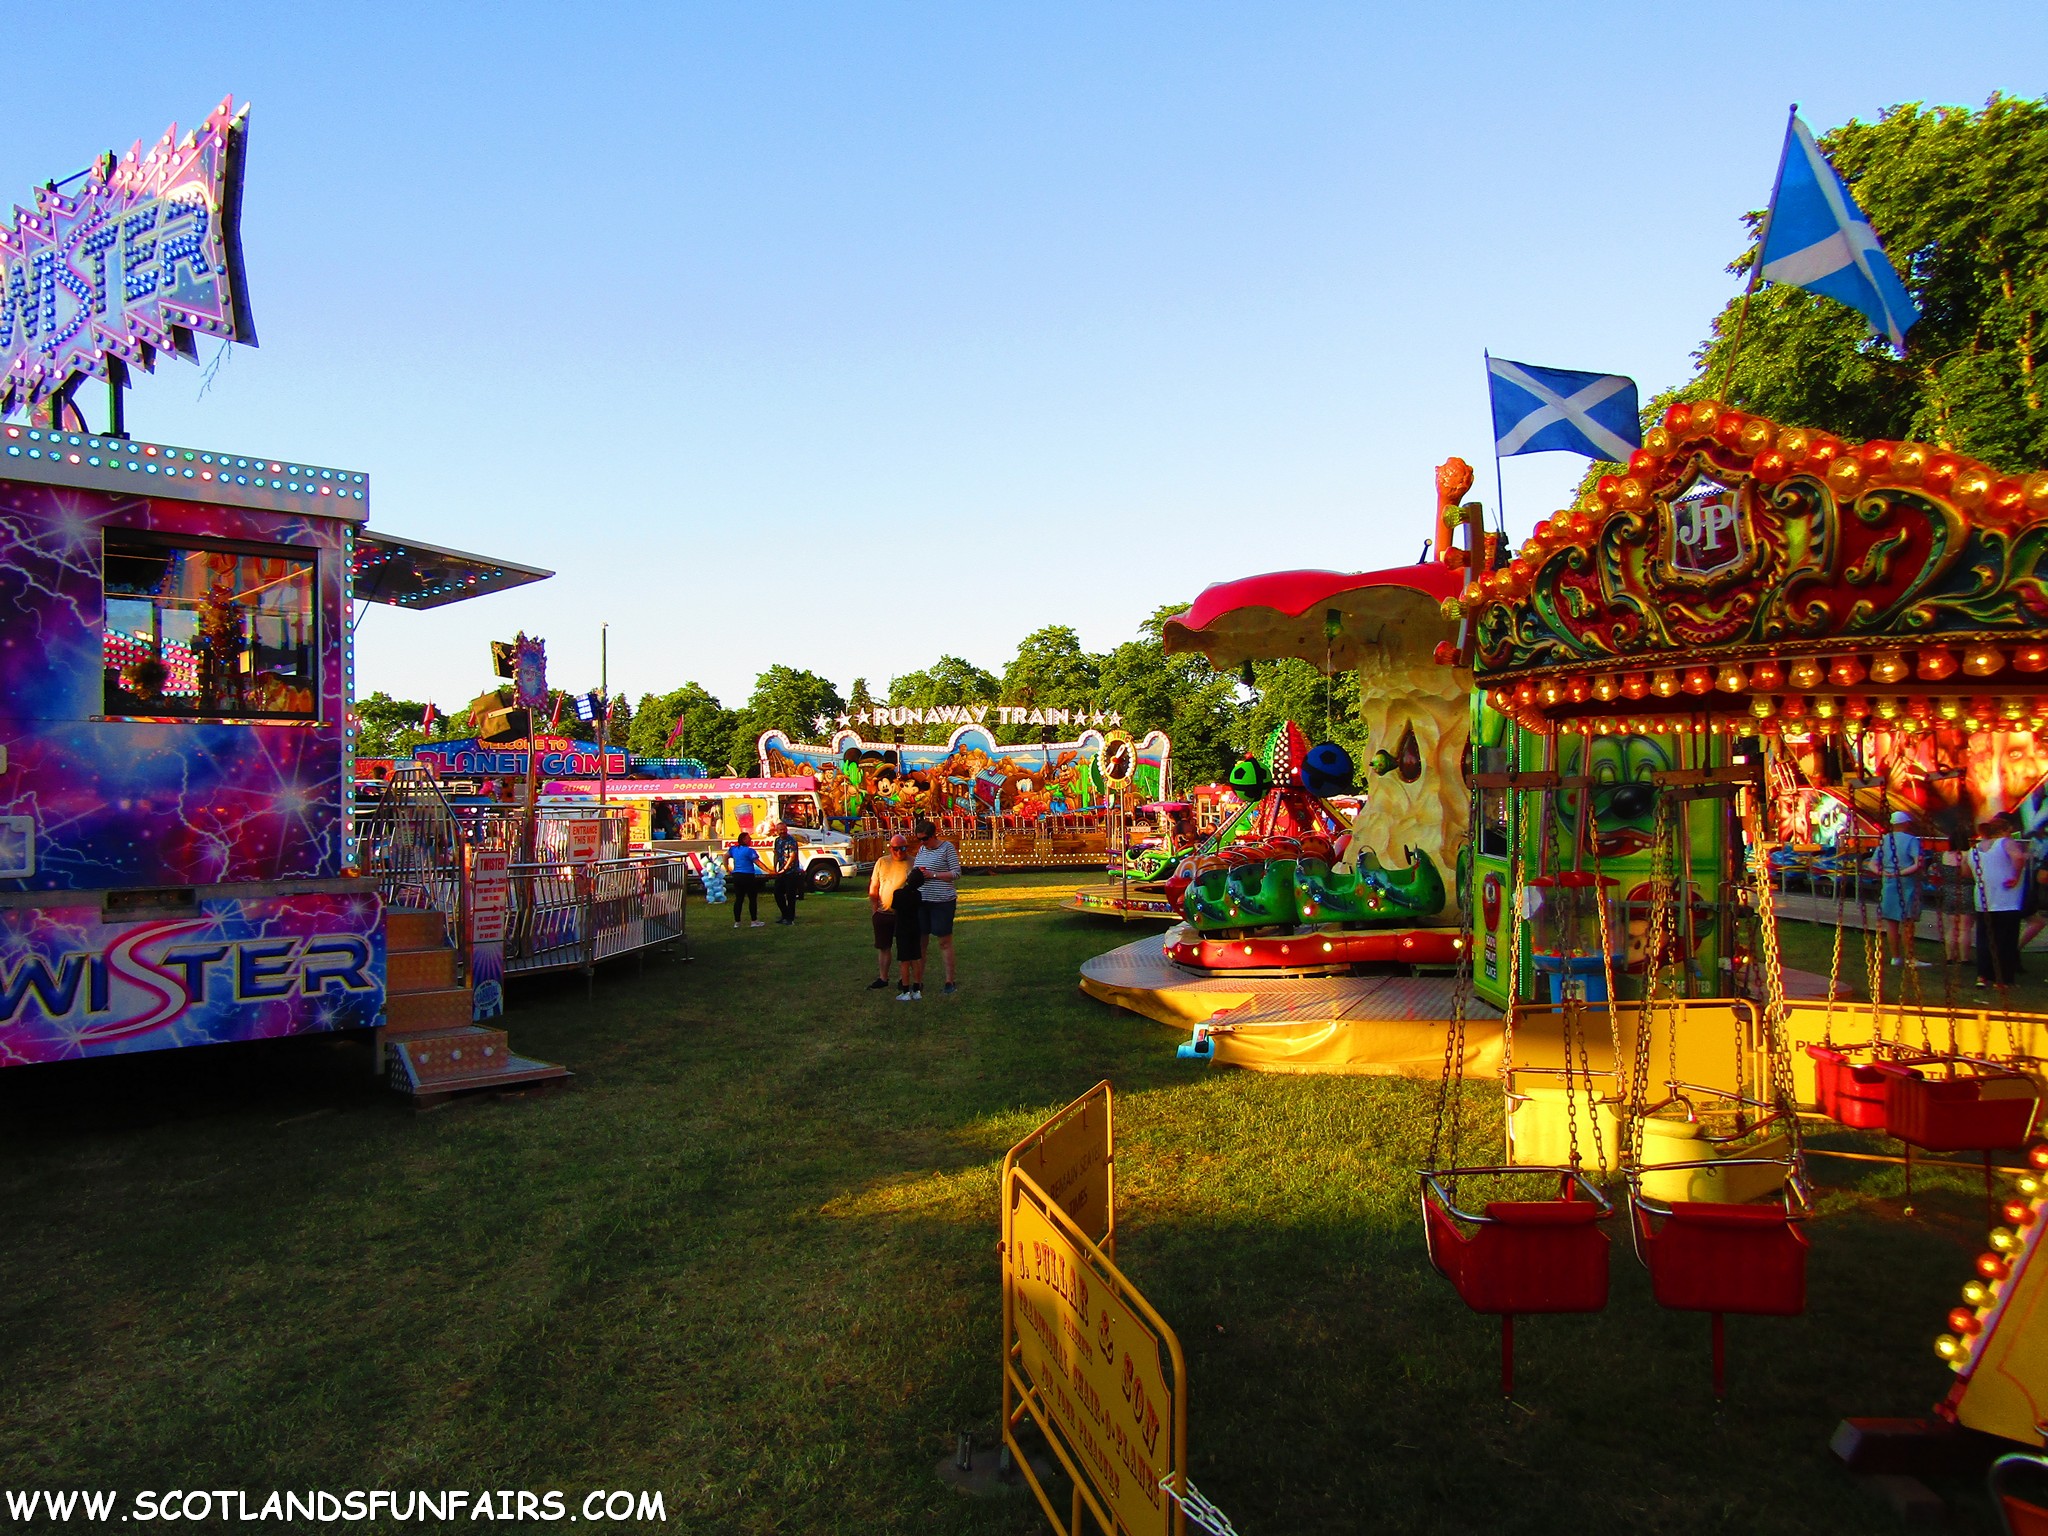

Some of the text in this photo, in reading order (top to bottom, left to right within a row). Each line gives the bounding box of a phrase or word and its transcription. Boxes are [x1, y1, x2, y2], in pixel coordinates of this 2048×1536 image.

[1680, 499, 1732, 550] JP
[873, 704, 1069, 726] RUNAWAY TRAIN
[478, 739, 568, 750] WELCOE TO
[542, 752, 626, 774] GAME
[562, 782, 798, 793] SLUSH CANDYFLOSS POPCORN SOFT ICE CREAM
[573, 825, 597, 835] ENTRANCE
[574, 835, 596, 845] THIS WAY
[751, 840, 774, 848] REAM
[480, 857, 505, 872] TWISTER
[1017, 1286, 1069, 1380] TRADITIONAL
[1033, 1240, 1089, 1328] PULLAR
[1098, 1309, 1114, 1365] &
[1122, 1351, 1160, 1458] SON
[1079, 1416, 1120, 1499] PLEASURE
